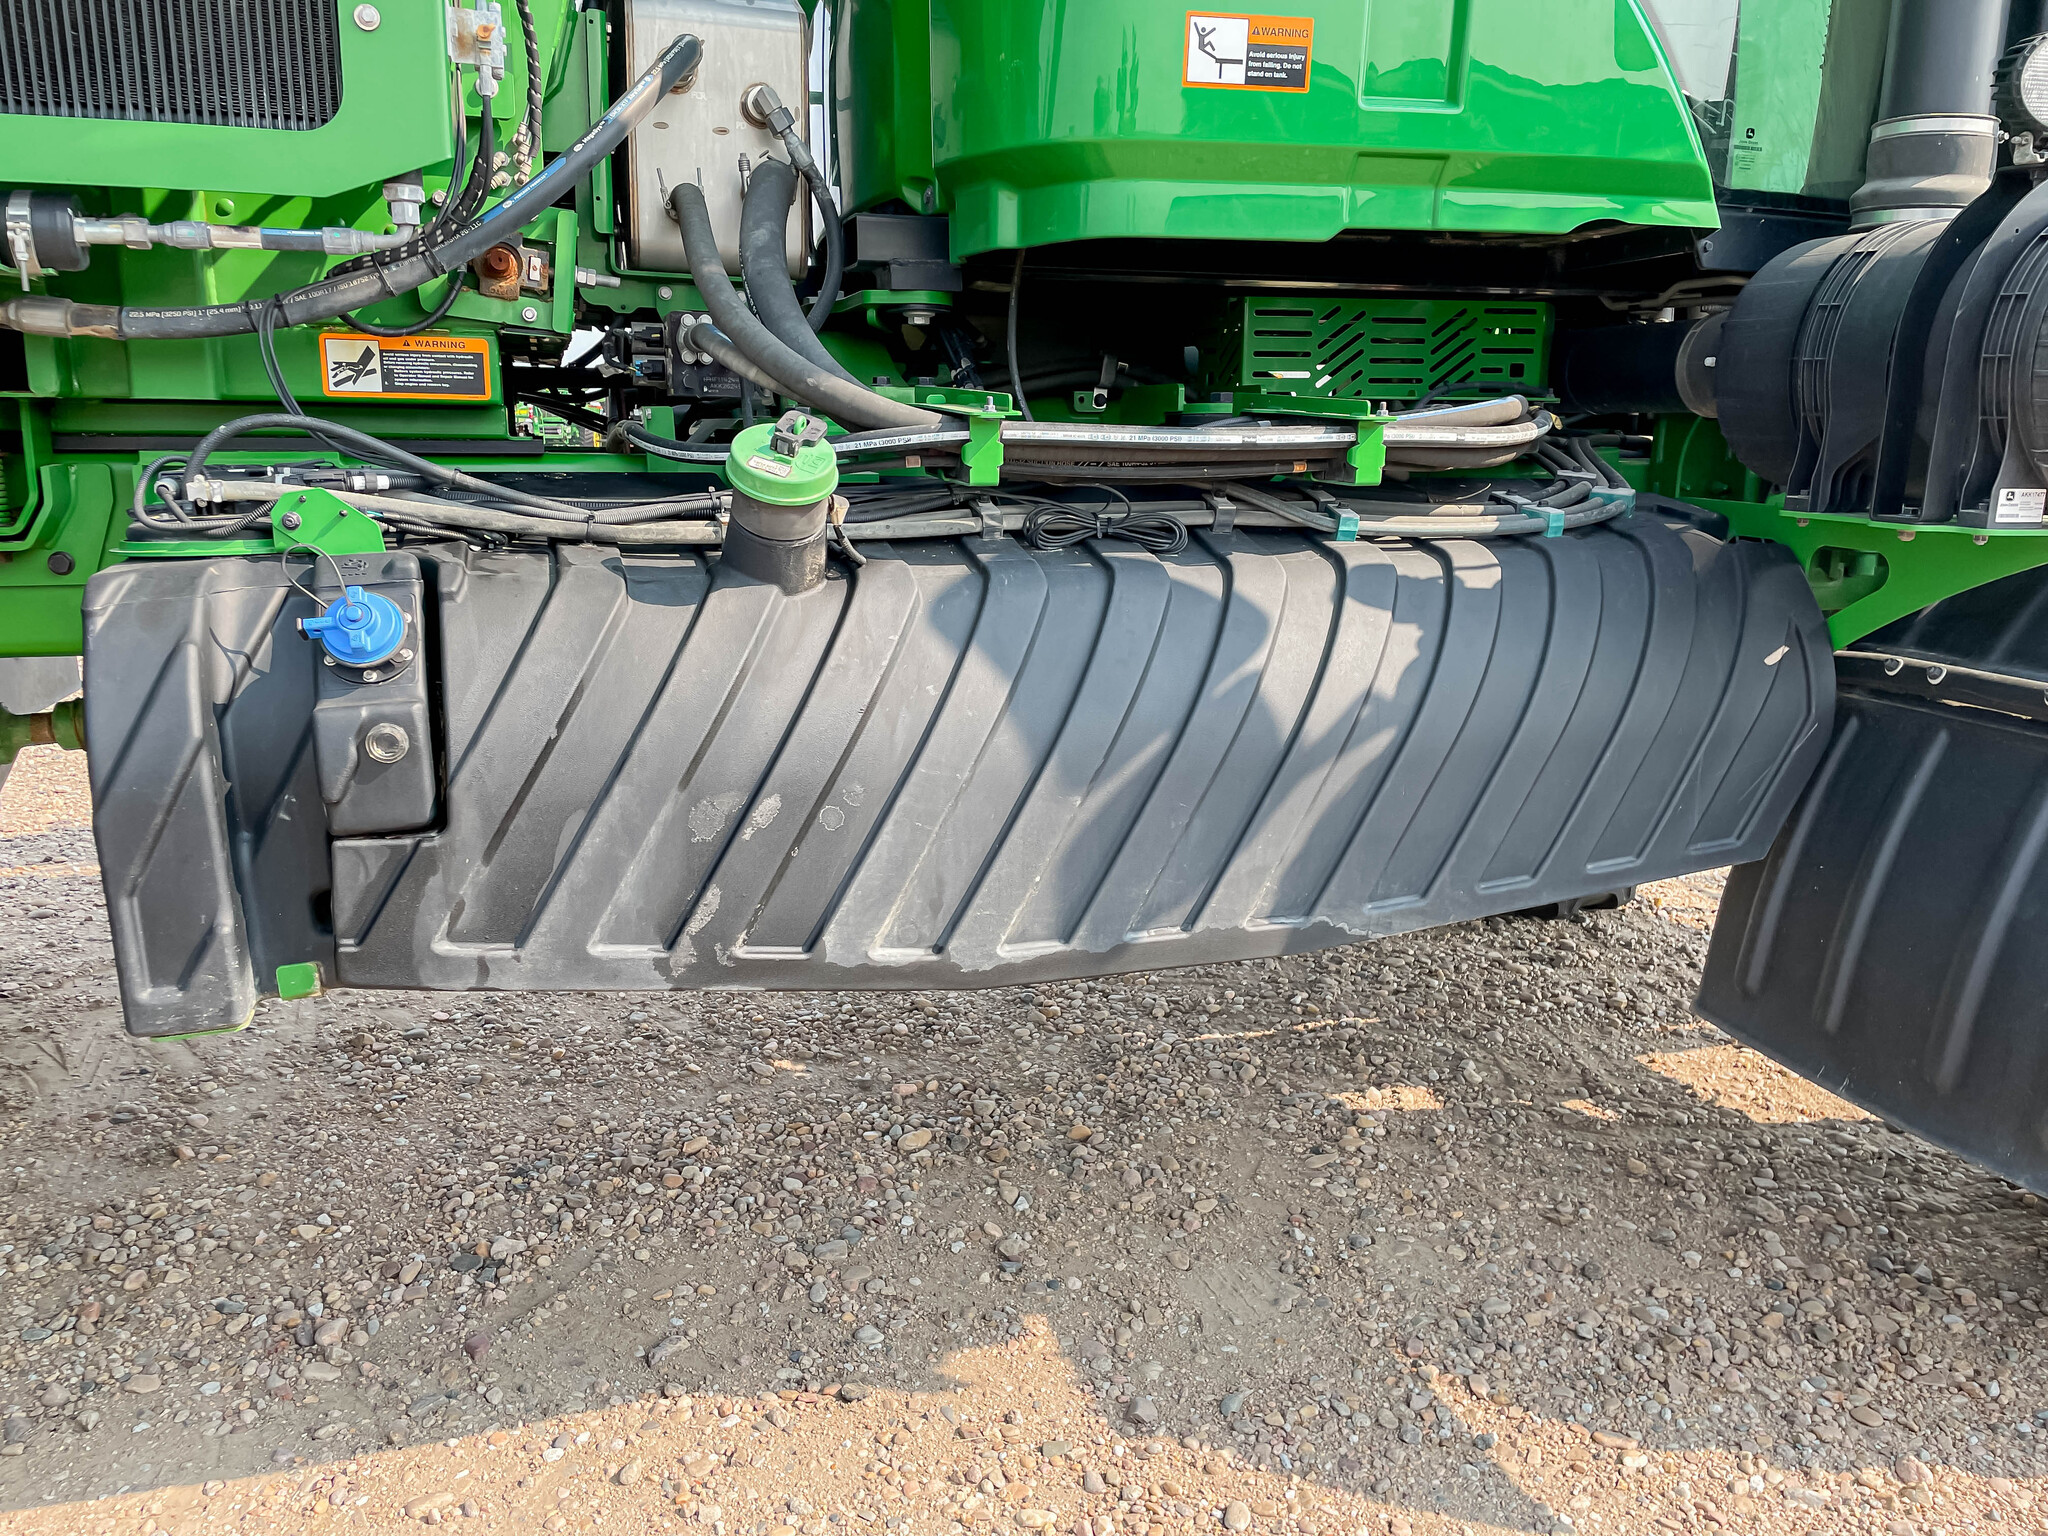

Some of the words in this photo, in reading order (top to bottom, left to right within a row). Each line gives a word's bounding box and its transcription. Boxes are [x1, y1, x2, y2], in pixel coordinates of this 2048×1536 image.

[1261, 27, 1309, 38] WARNING
[1267, 51, 1287, 59] serious
[1289, 53, 1305, 61] injury
[1263, 61, 1282, 69] falling.
[294, 294, 307, 302] SAE
[415, 340, 466, 349] WARNING
[863, 440, 878, 448] MPa
[878, 438, 897, 447] (3000
